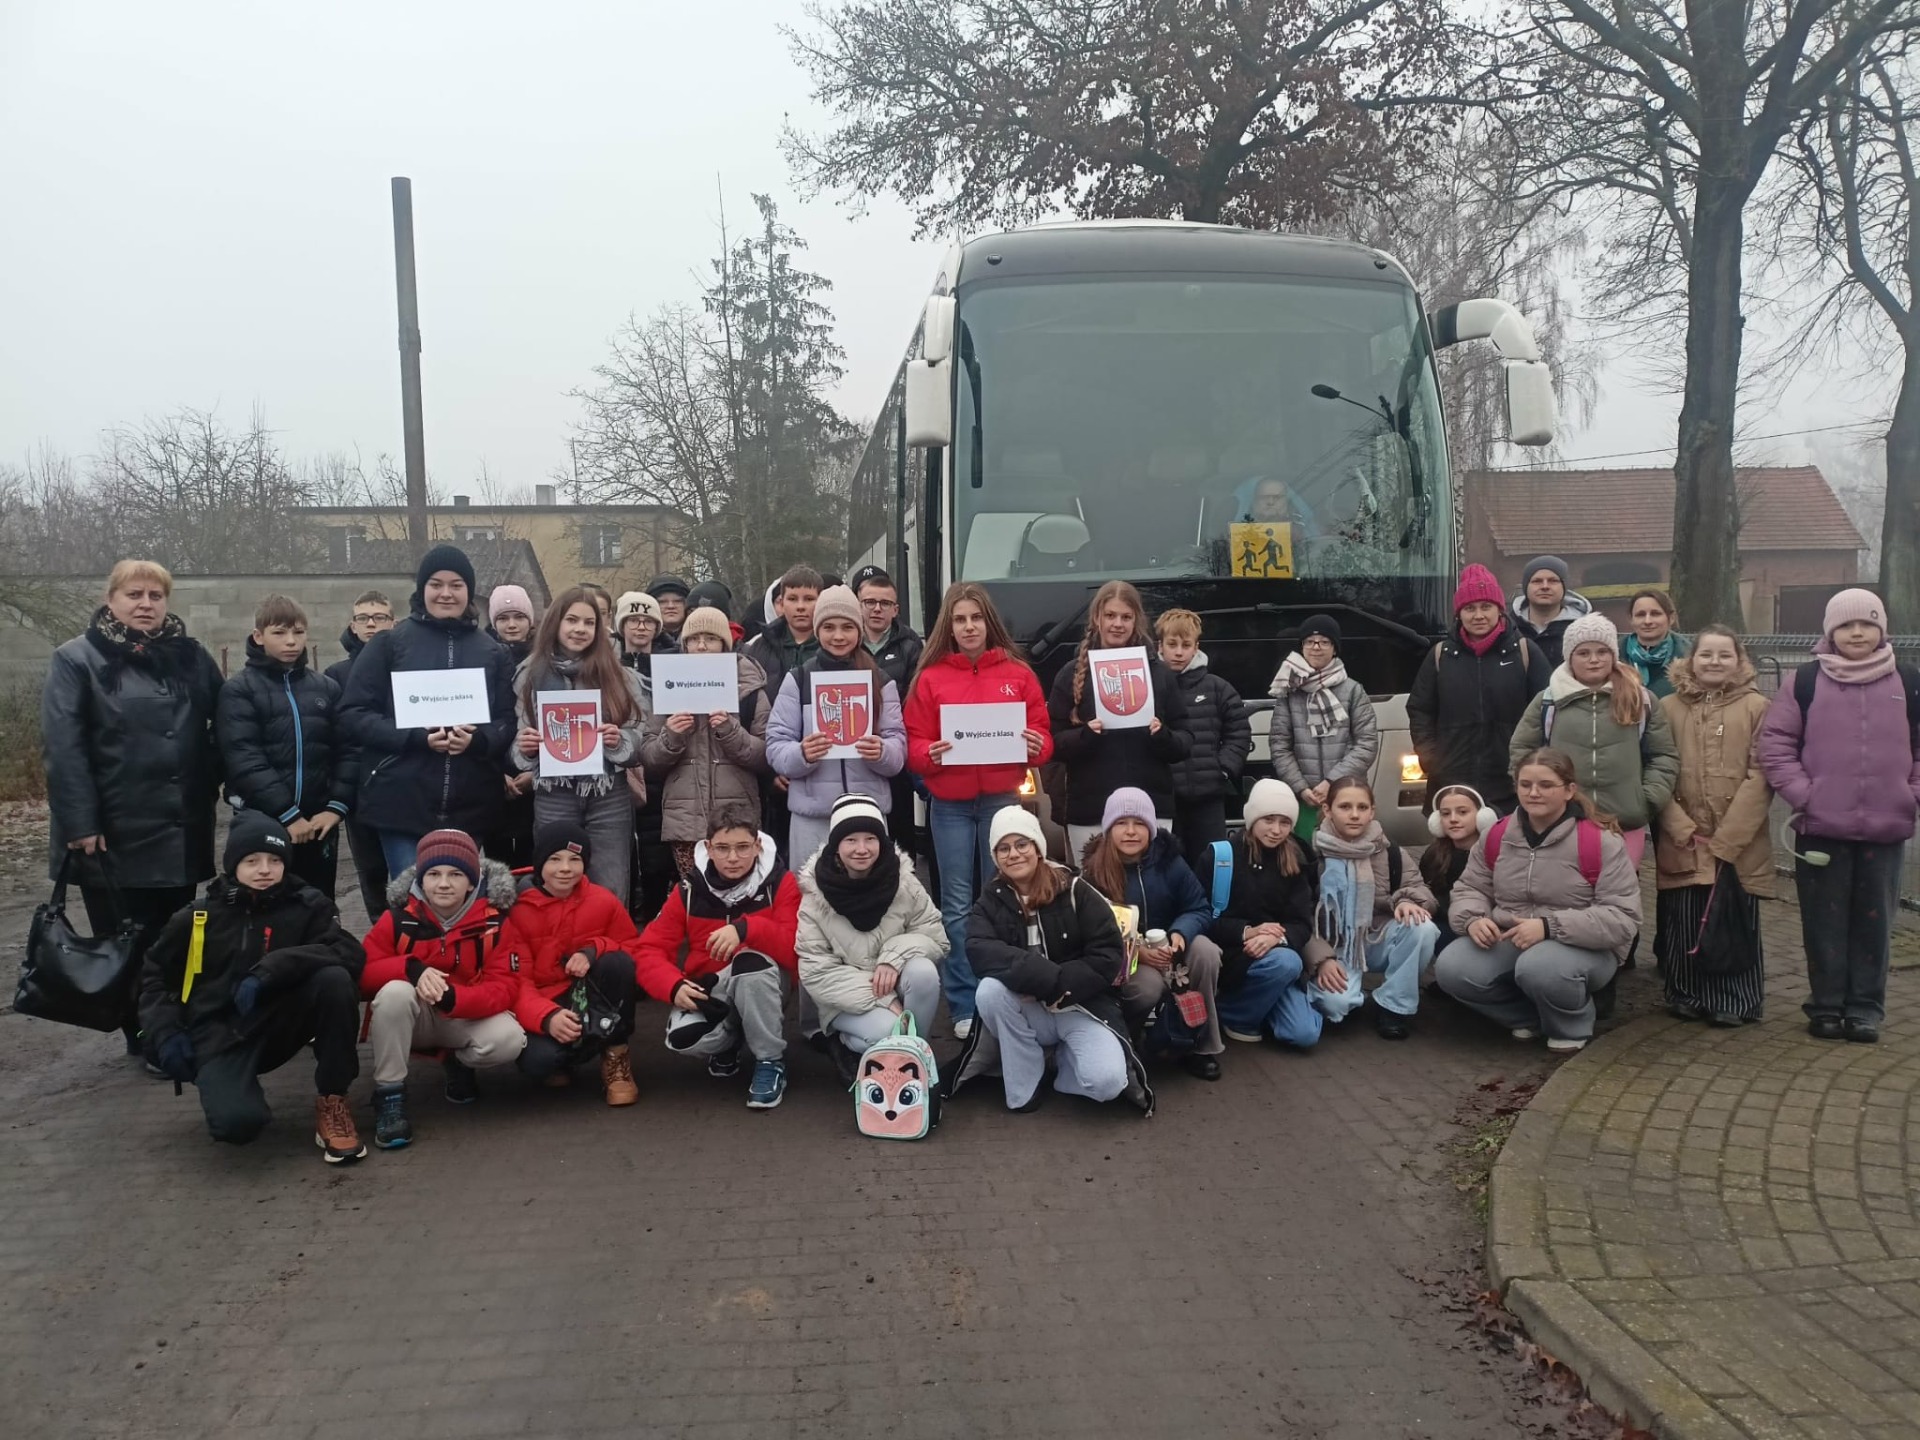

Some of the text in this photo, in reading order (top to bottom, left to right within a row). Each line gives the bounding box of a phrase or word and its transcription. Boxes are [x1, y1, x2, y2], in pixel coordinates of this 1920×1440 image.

[630, 603, 651, 614] NY
[676, 680, 702, 688] Wyjście
[708, 680, 725, 688] klasą
[965, 730, 992, 738] Wyjście
